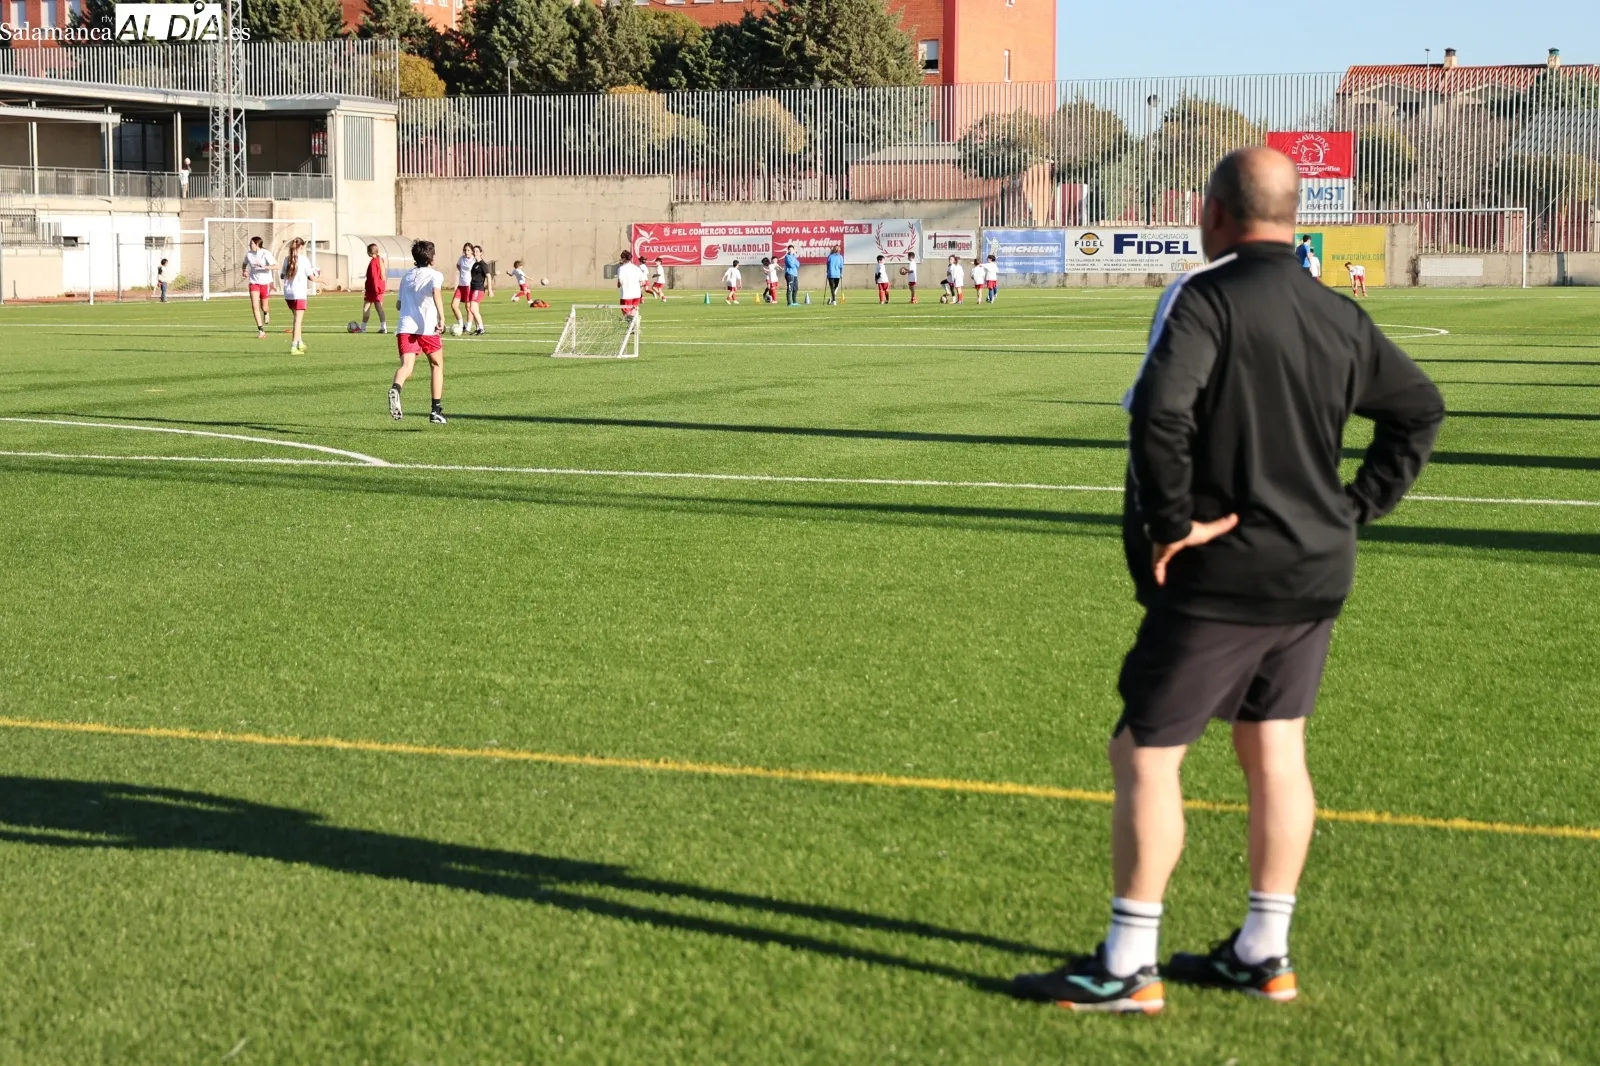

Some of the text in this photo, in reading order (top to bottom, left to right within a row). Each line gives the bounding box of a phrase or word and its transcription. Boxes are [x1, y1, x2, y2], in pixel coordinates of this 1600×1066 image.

[1307, 186, 1345, 201] MST
[1306, 200, 1344, 210] eventos
[688, 227, 727, 236] COMERCIO
[727, 227, 744, 235] DEL
[775, 225, 800, 235] APOYA
[801, 225, 811, 234] AL
[829, 225, 860, 234] NAVEGA
[886, 239, 905, 248] REX
[932, 232, 973, 251] José Miguel
[1113, 233, 1198, 255] FIDEL
[642, 245, 698, 253] TARDAGUILA
[722, 243, 770, 253] VALLADOLID
[1001, 245, 1059, 254] MICHELIN
